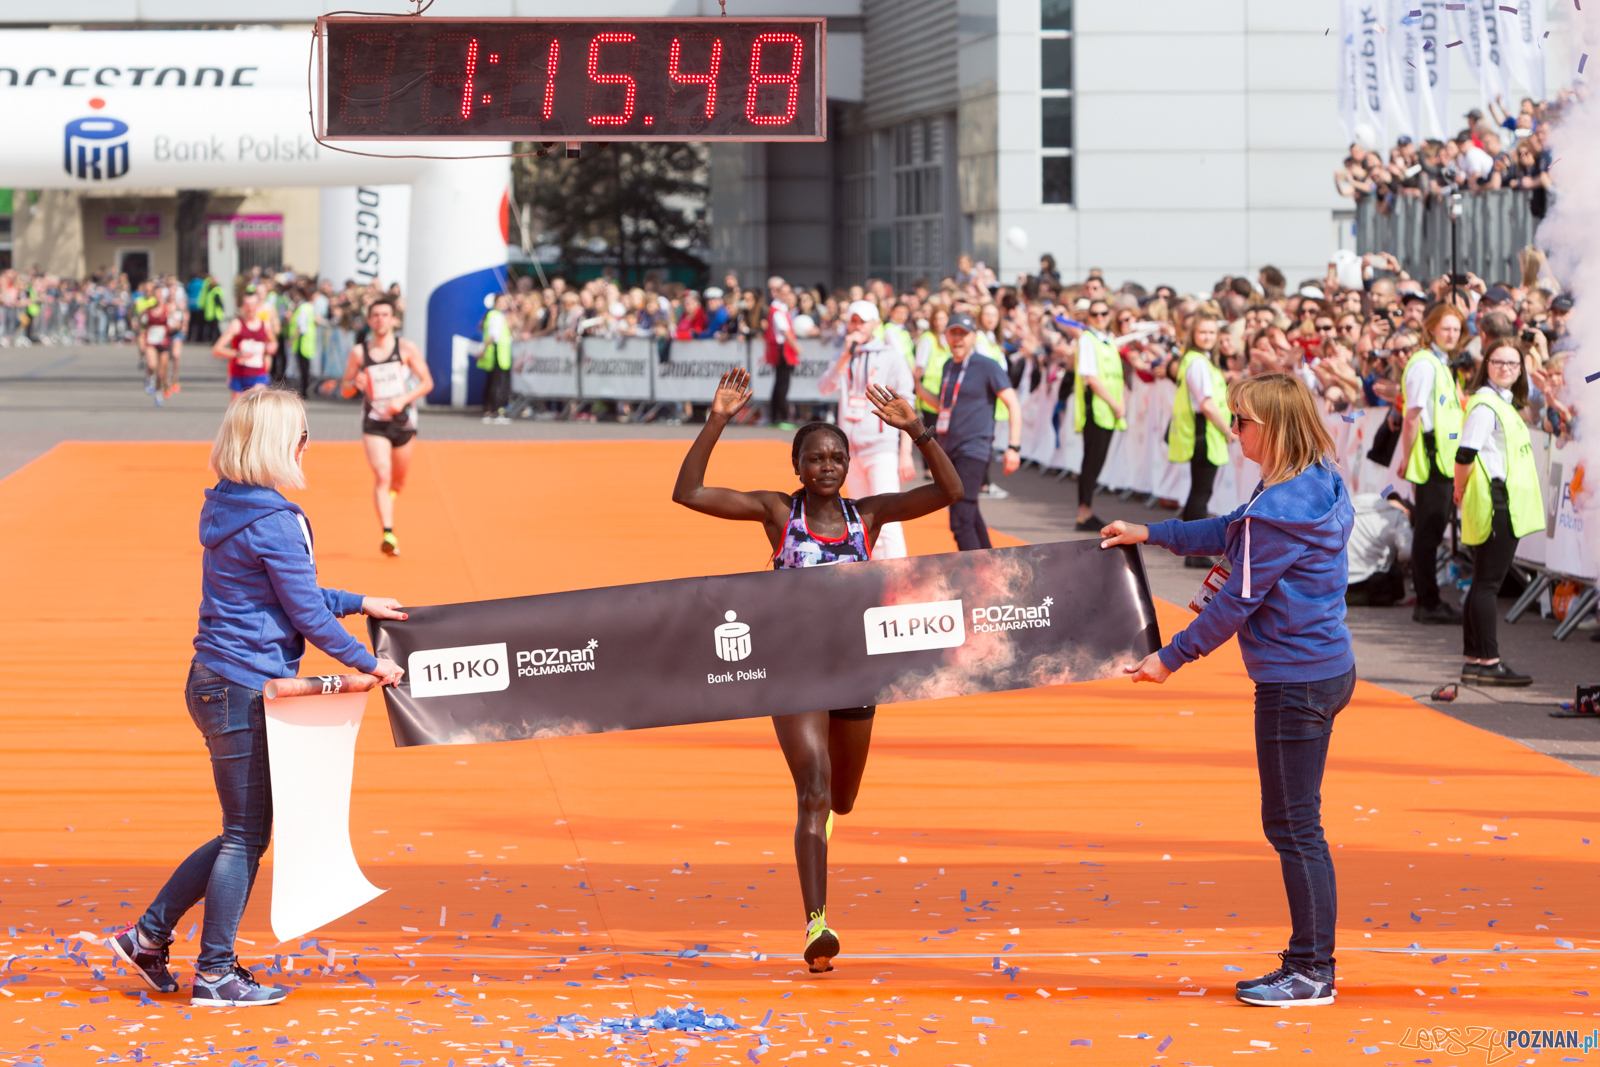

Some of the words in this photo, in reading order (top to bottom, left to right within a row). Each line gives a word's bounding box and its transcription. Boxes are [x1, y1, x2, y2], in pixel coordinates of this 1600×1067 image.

[154, 134, 227, 162] Bank
[238, 133, 320, 162] Polski
[878, 619, 904, 638] 11.
[908, 614, 955, 636] PKO
[973, 618, 1051, 633] PÓŁMARATON
[422, 662, 448, 682] 11.
[452, 658, 499, 680] PKO
[517, 661, 595, 677] PÓŁMARATON
[707, 671, 734, 684] Bank
[736, 668, 767, 681] Polski
